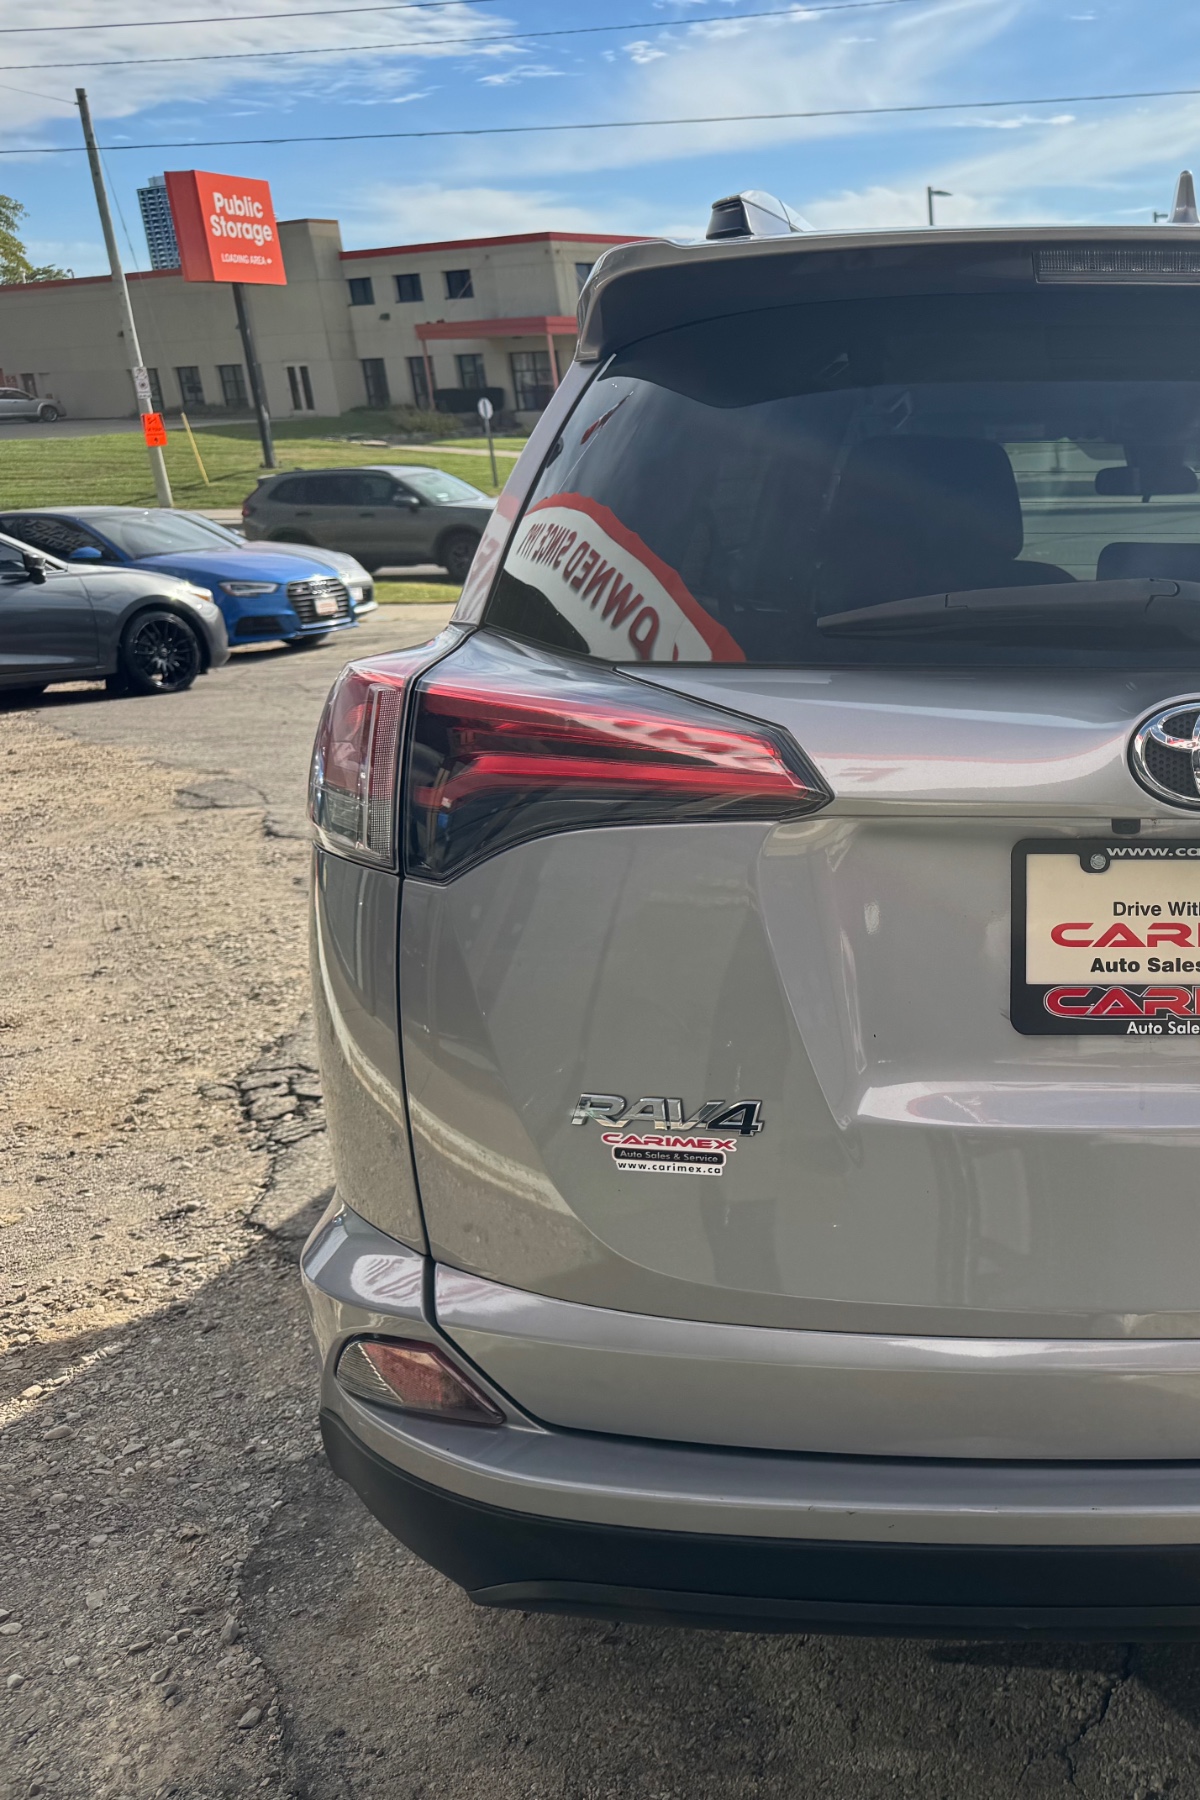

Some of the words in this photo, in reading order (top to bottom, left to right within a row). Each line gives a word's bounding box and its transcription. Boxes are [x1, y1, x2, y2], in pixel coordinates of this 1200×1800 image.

[213, 192, 263, 218] Public
[210, 214, 273, 246] Storage
[221, 253, 249, 263] LOADING
[250, 254, 266, 265] AREA
[1113, 901, 1162, 917] Drive
[1090, 957, 1141, 973] Auto
[1126, 1021, 1163, 1035] Auto
[571, 1092, 765, 1137] RAV4
[602, 1133, 736, 1150] CARIMEX
[619, 1149, 643, 1159] Auto
[645, 1151, 671, 1161] Sales
[673, 1153, 681, 1161] &
[683, 1152, 719, 1163] Service
[617, 1160, 721, 1174] www.carimex.ca
